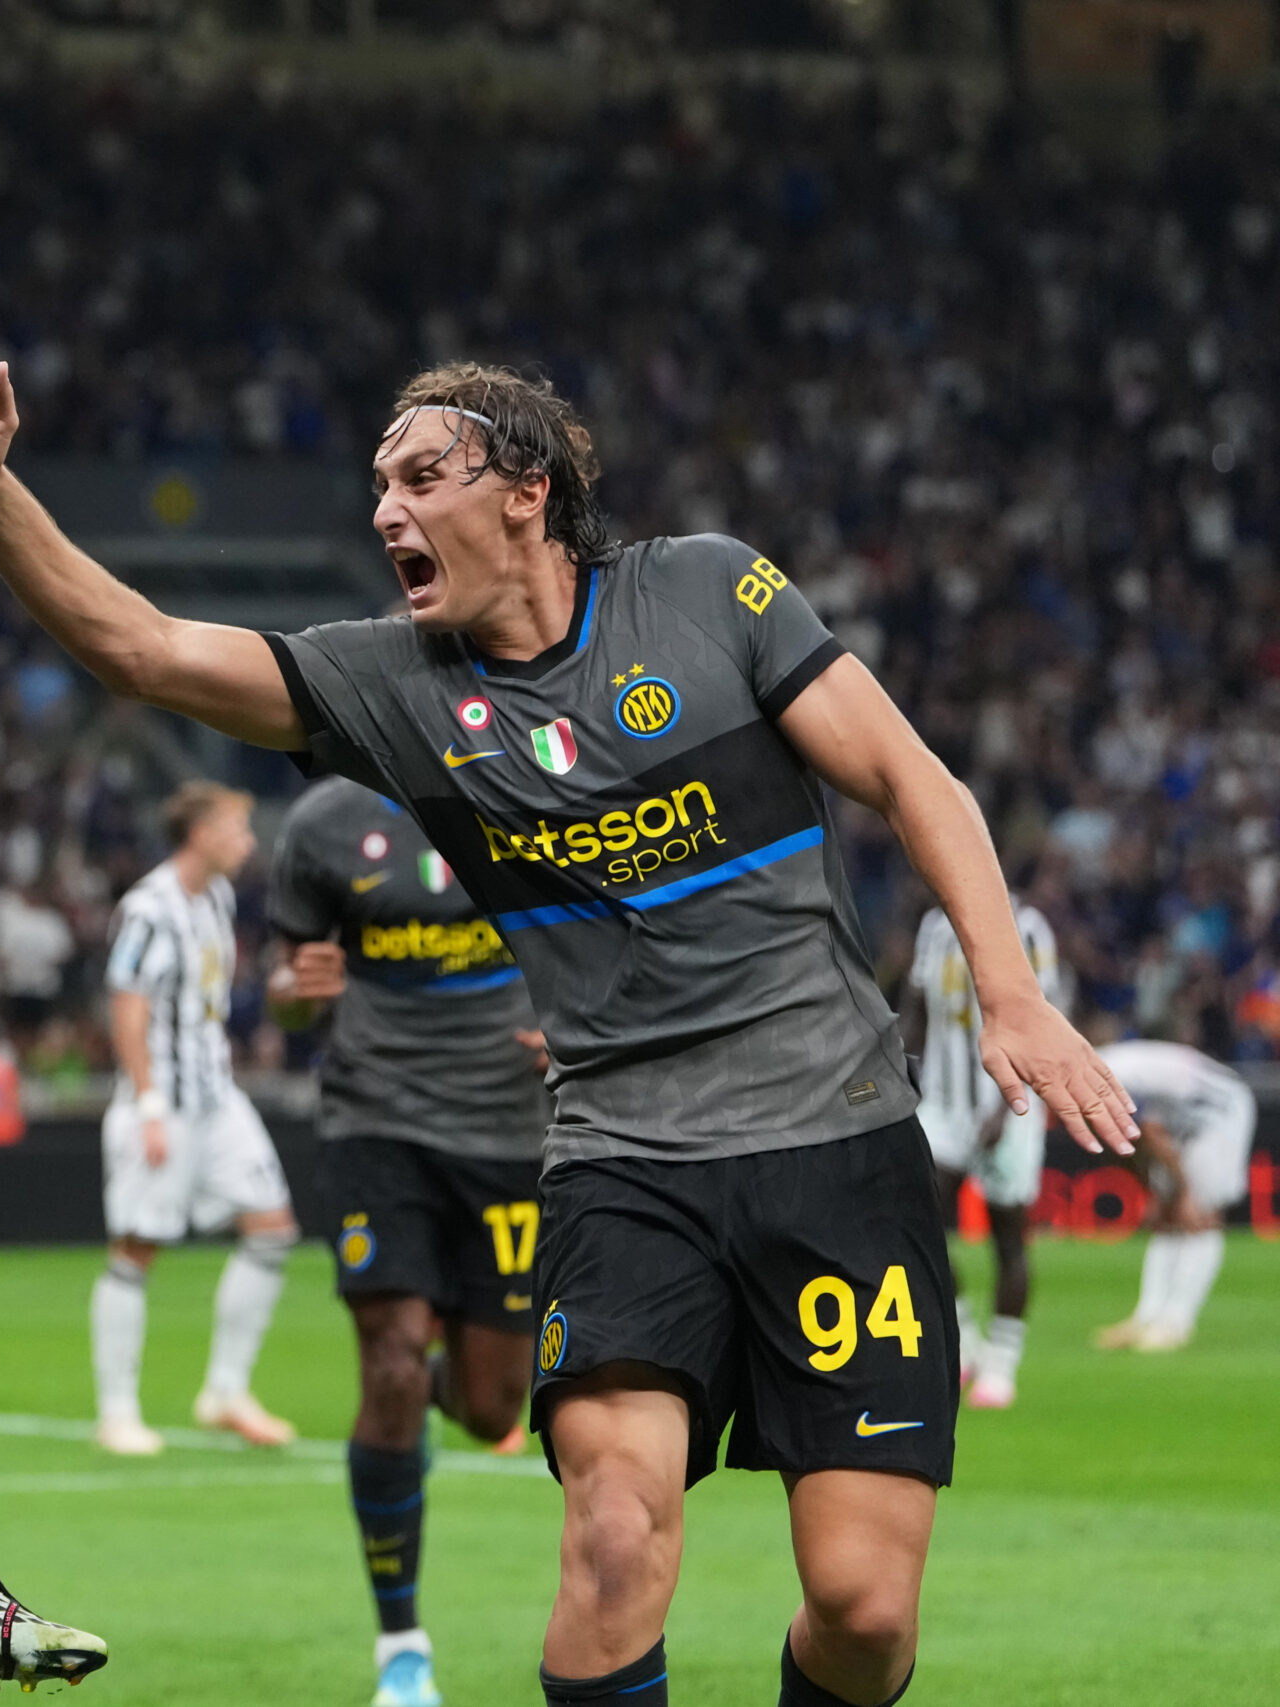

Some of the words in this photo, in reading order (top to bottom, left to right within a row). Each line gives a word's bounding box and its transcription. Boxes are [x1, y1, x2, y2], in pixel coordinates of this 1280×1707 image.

[475, 781, 717, 868] betsson
[601, 818, 727, 887] .sport
[482, 1200, 540, 1275] 17
[798, 1265, 923, 1372] 94
